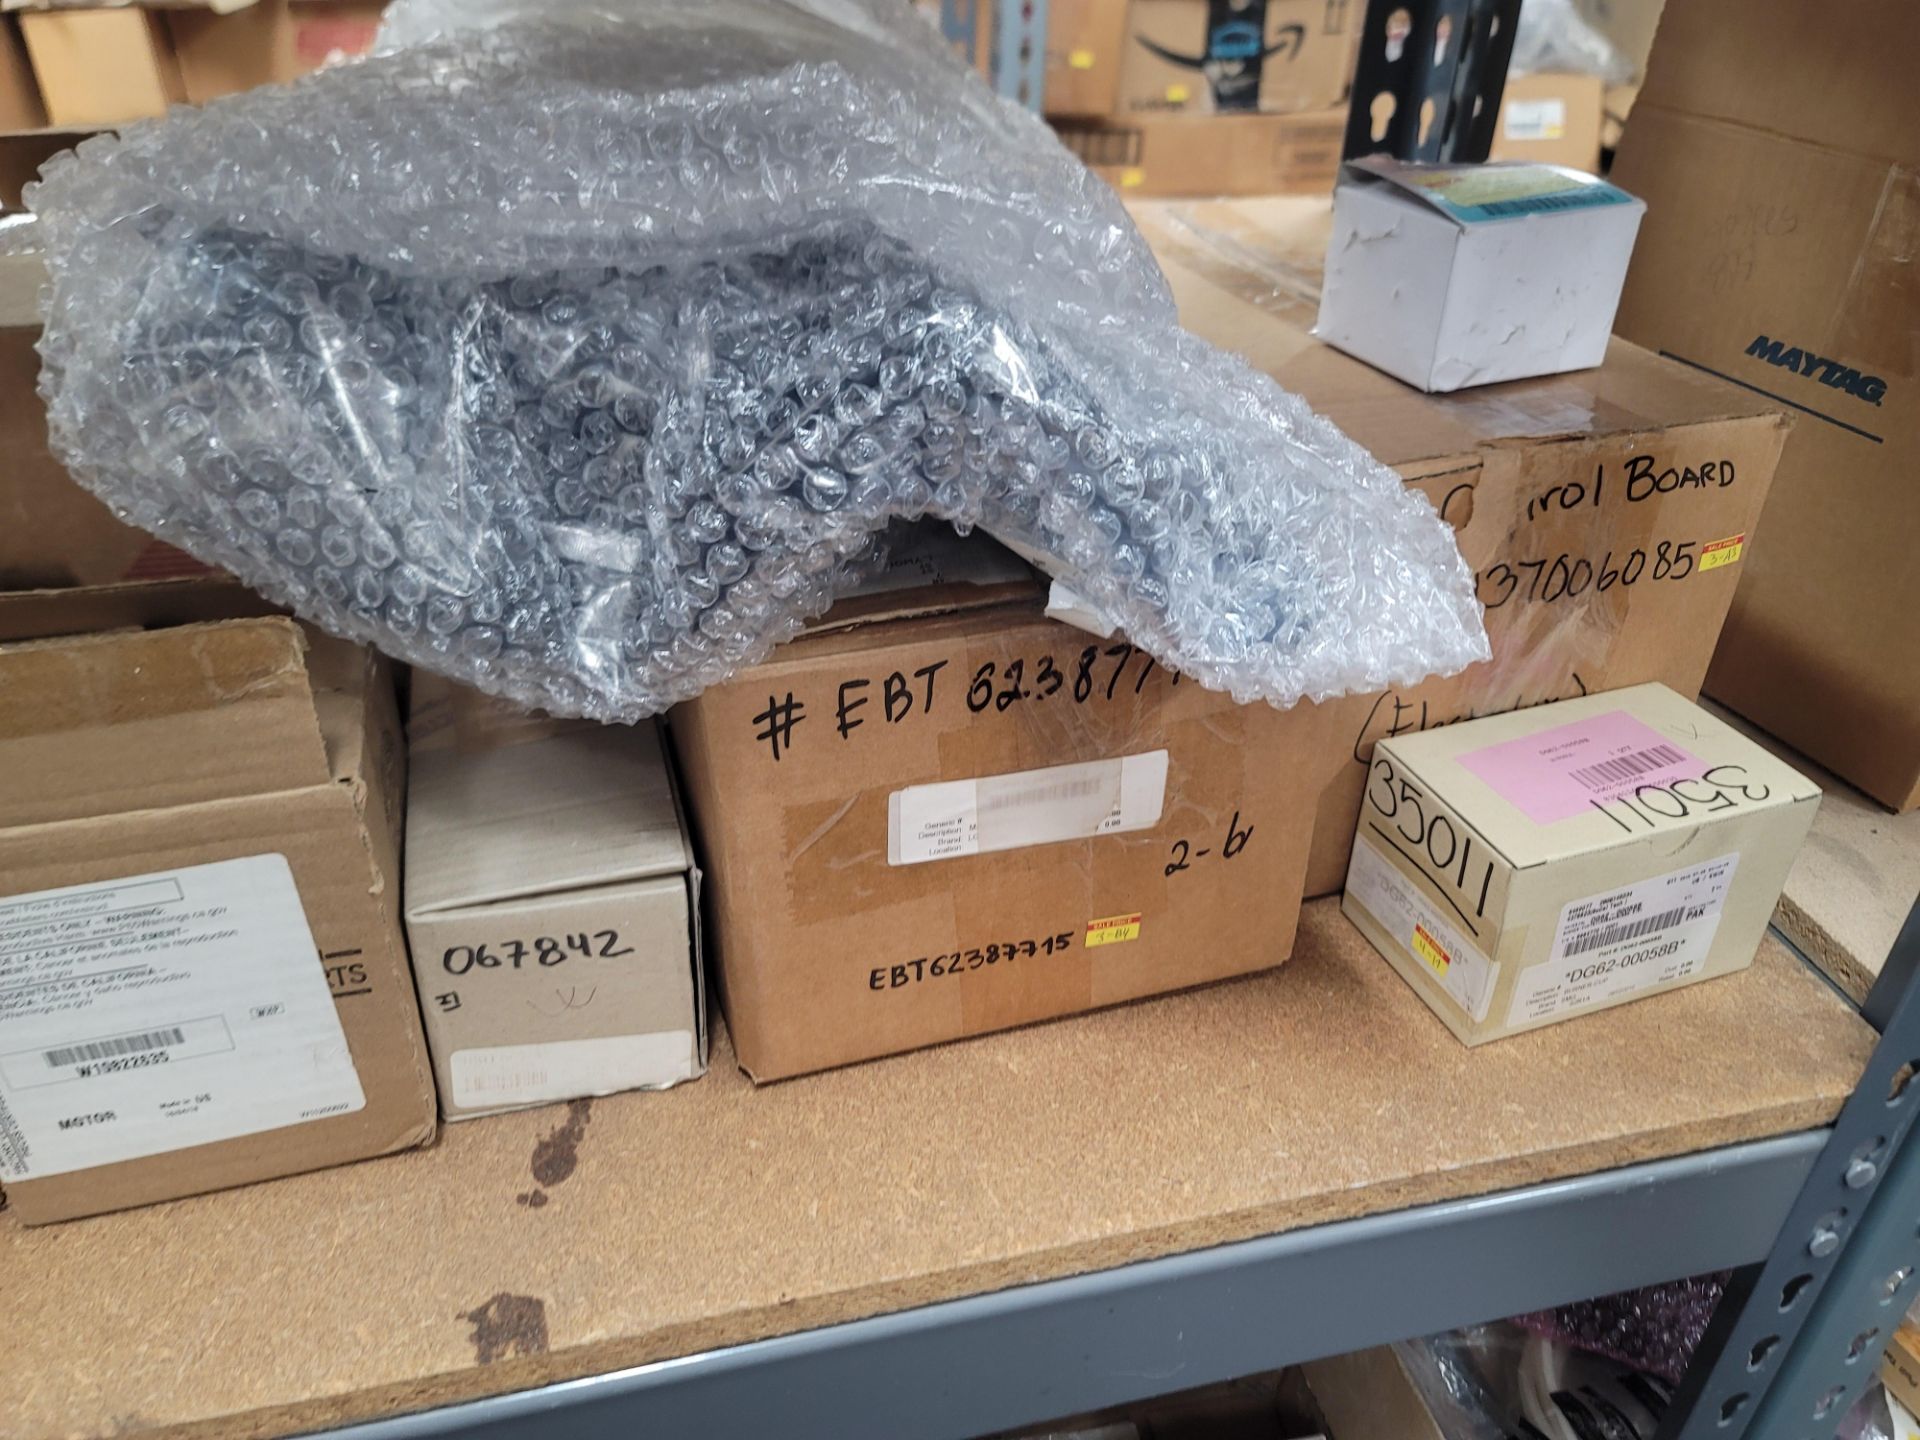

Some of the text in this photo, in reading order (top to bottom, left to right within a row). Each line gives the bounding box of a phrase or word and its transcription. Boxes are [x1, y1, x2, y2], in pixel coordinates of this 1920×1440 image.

[752, 643, 1181, 761] # EBT 623877
[1591, 765, 1770, 833] 35011
[1369, 758, 1494, 918] 35011
[442, 929, 636, 976] 067842
[868, 930, 1076, 991] EBT62387715
